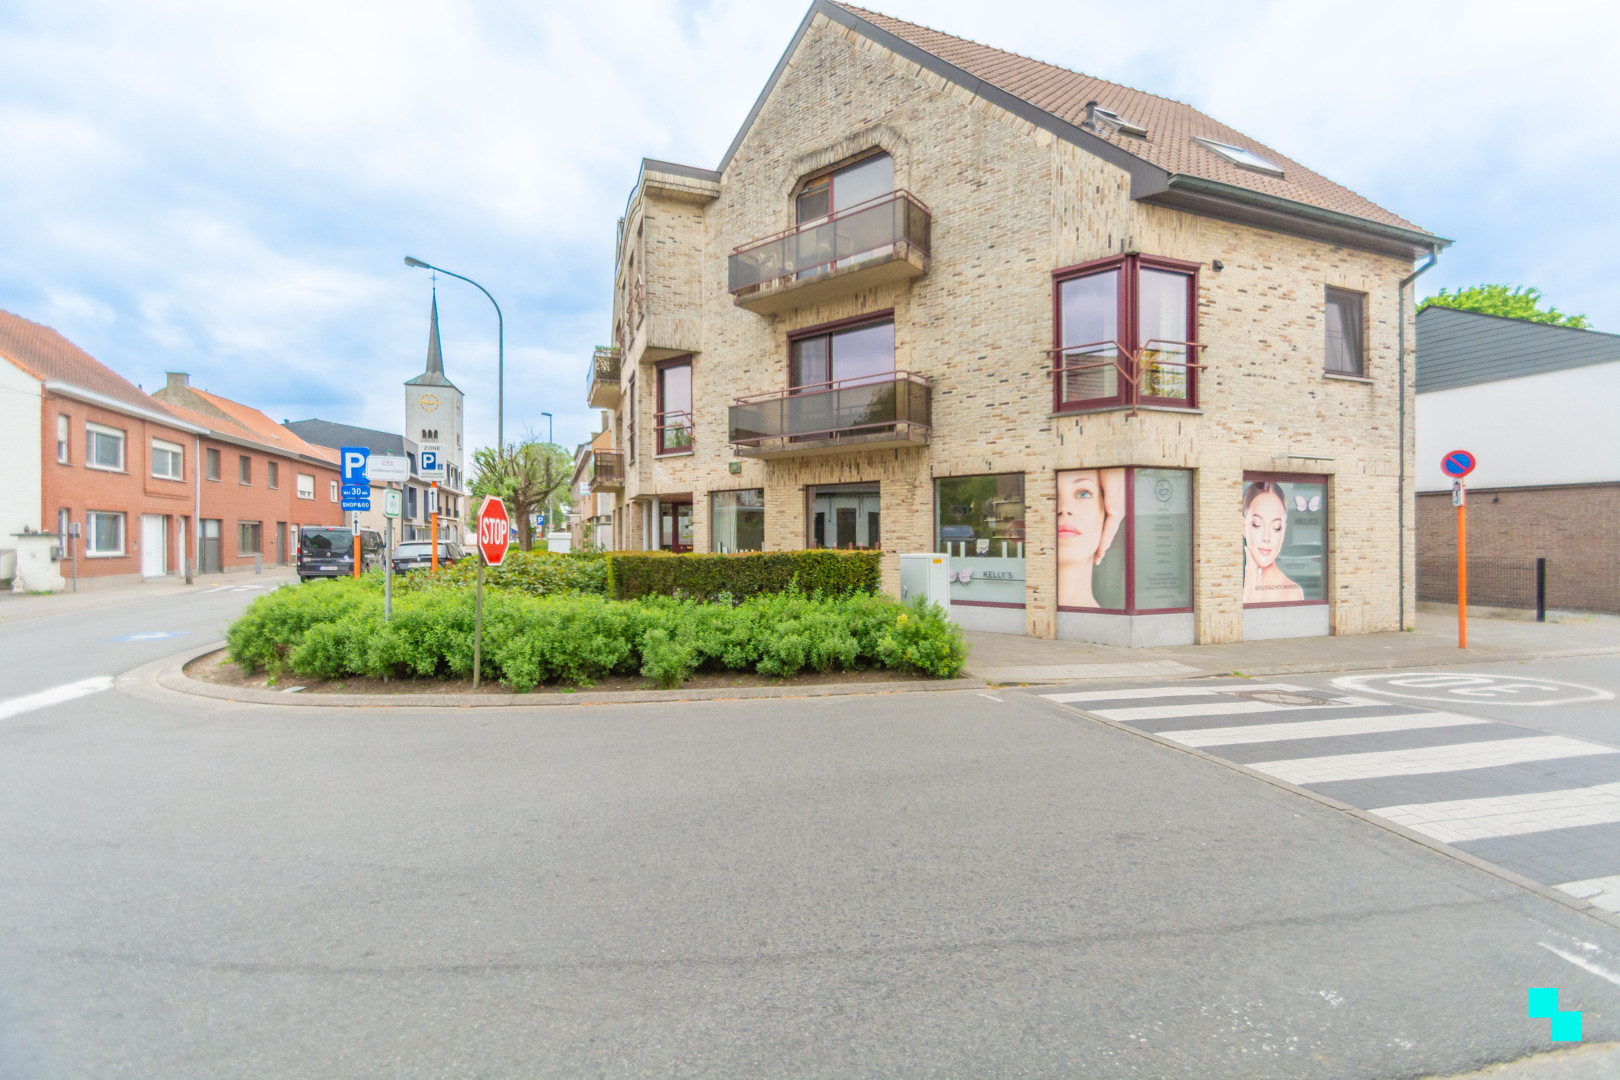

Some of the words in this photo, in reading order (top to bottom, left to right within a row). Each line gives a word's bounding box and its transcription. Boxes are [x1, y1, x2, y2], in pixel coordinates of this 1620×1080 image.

[345, 452, 365, 479] P
[423, 454, 435, 469] P
[351, 487, 362, 496] 30
[482, 517, 507, 545] STOP
[983, 571, 1013, 579] KELLY'S
[1387, 676, 1559, 697] 30
